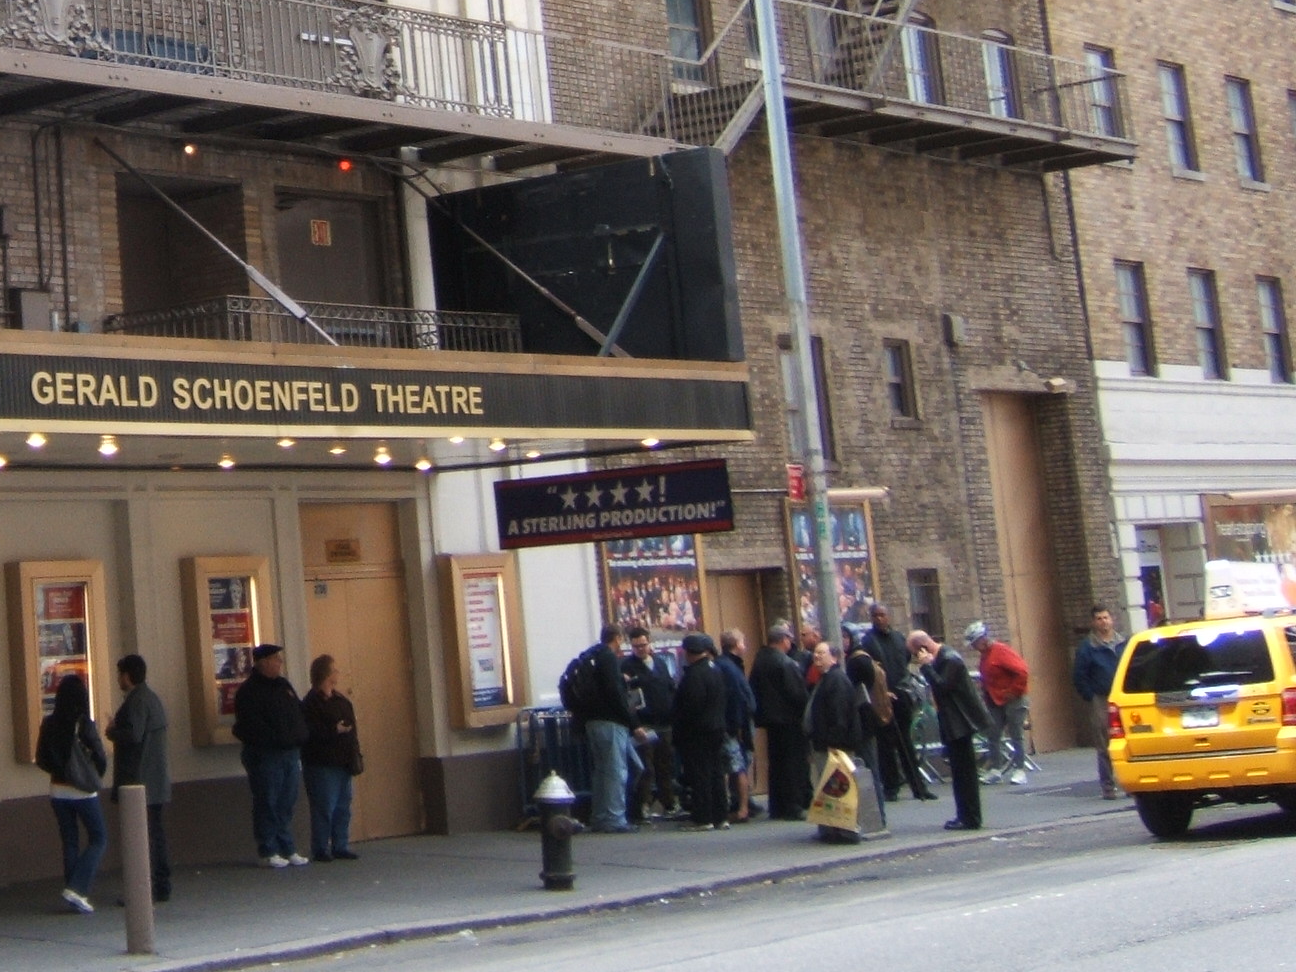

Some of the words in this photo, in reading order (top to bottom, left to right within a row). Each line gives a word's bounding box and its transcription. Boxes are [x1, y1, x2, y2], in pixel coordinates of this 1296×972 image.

[31, 371, 158, 407] GERALD
[172, 377, 359, 413] SCHOENFELD
[371, 383, 484, 415] THEATRE
[508, 519, 519, 536] A
[523, 514, 596, 535] STERLING
[599, 500, 726, 526] PRODUCTION!"
